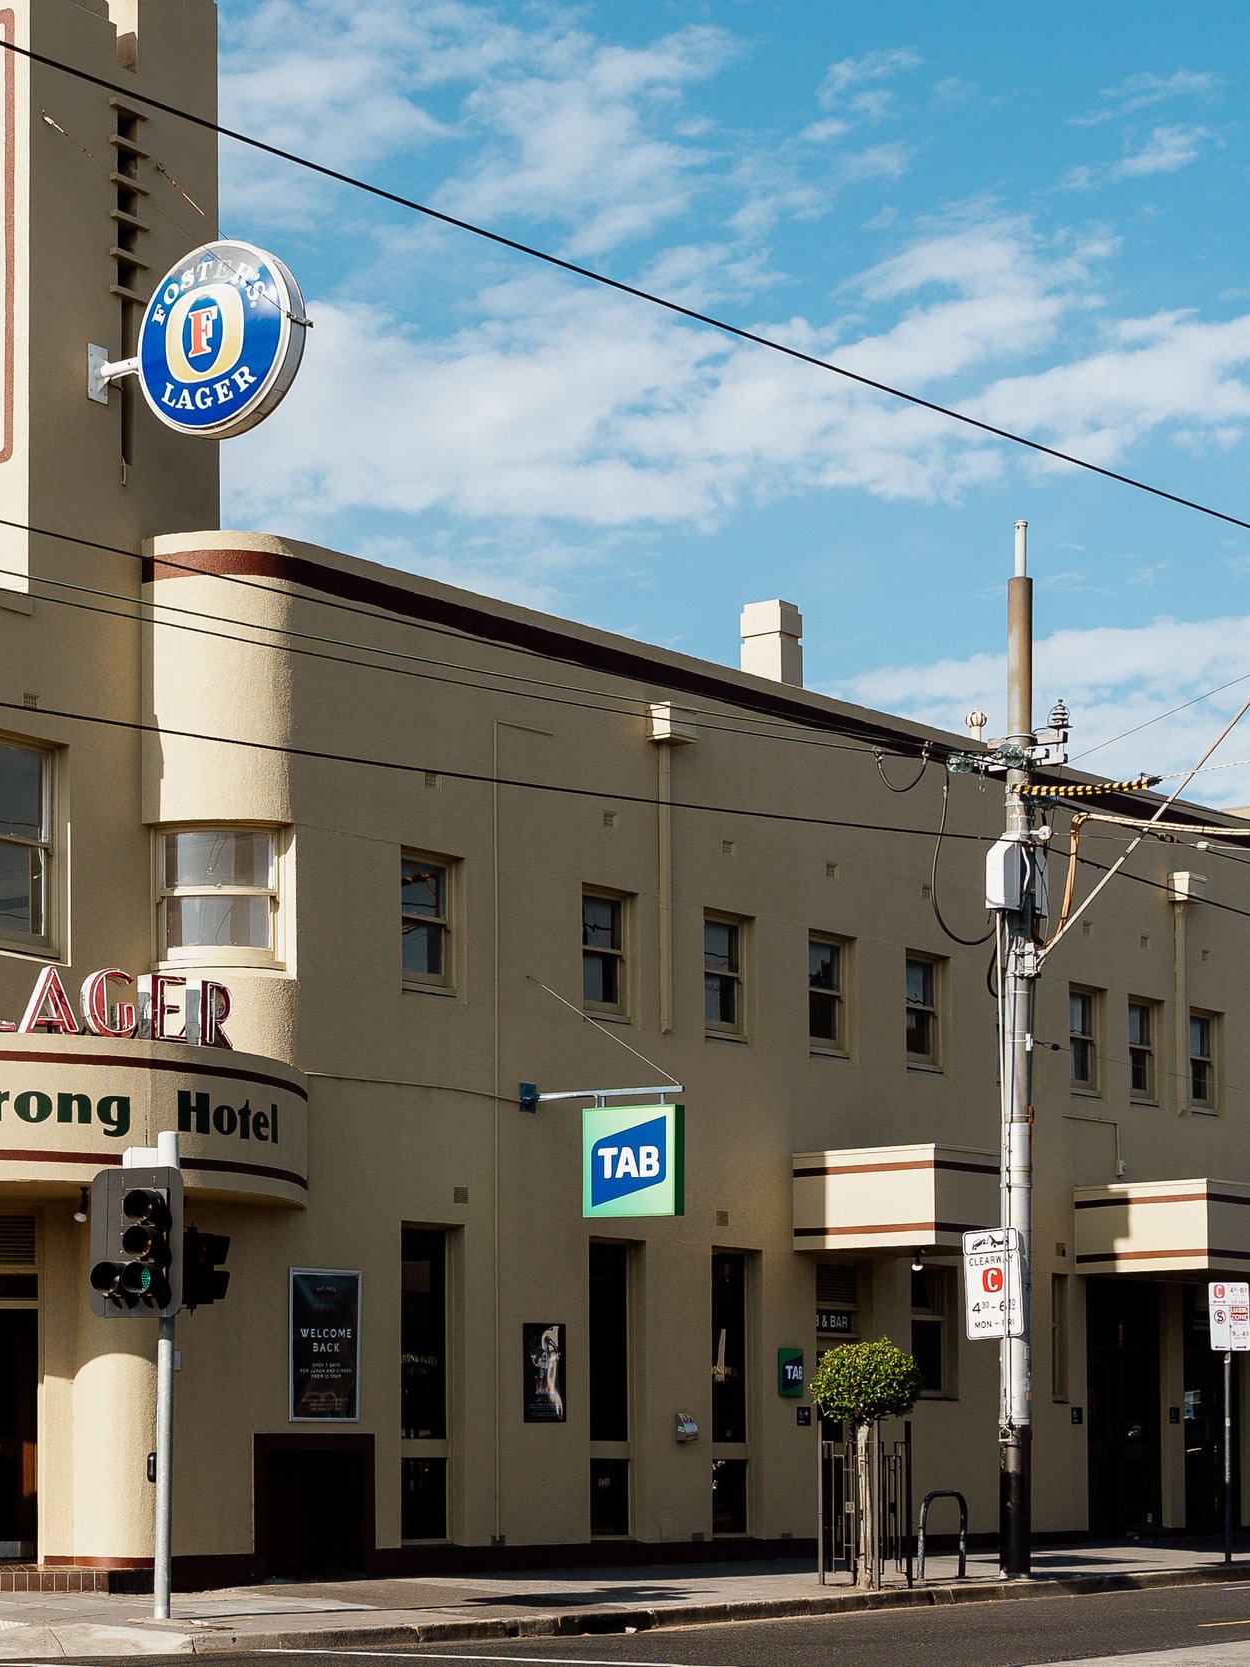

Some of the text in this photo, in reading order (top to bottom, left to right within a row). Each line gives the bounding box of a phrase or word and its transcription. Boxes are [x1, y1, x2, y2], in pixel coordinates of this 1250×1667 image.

[151, 259, 266, 326] FOSTER'S
[160, 365, 258, 410] LAGER
[177, 1090, 279, 1145] Hotel
[597, 1145, 660, 1179] TAB
[987, 1269, 998, 1291] C
[830, 1315, 848, 1329] BAR
[1216, 1311, 1224, 1322] S
[974, 1320, 992, 1329] MON
[300, 1328, 352, 1338] WELCOME
[312, 1342, 340, 1352] BACK
[785, 1365, 803, 1380] TAB
